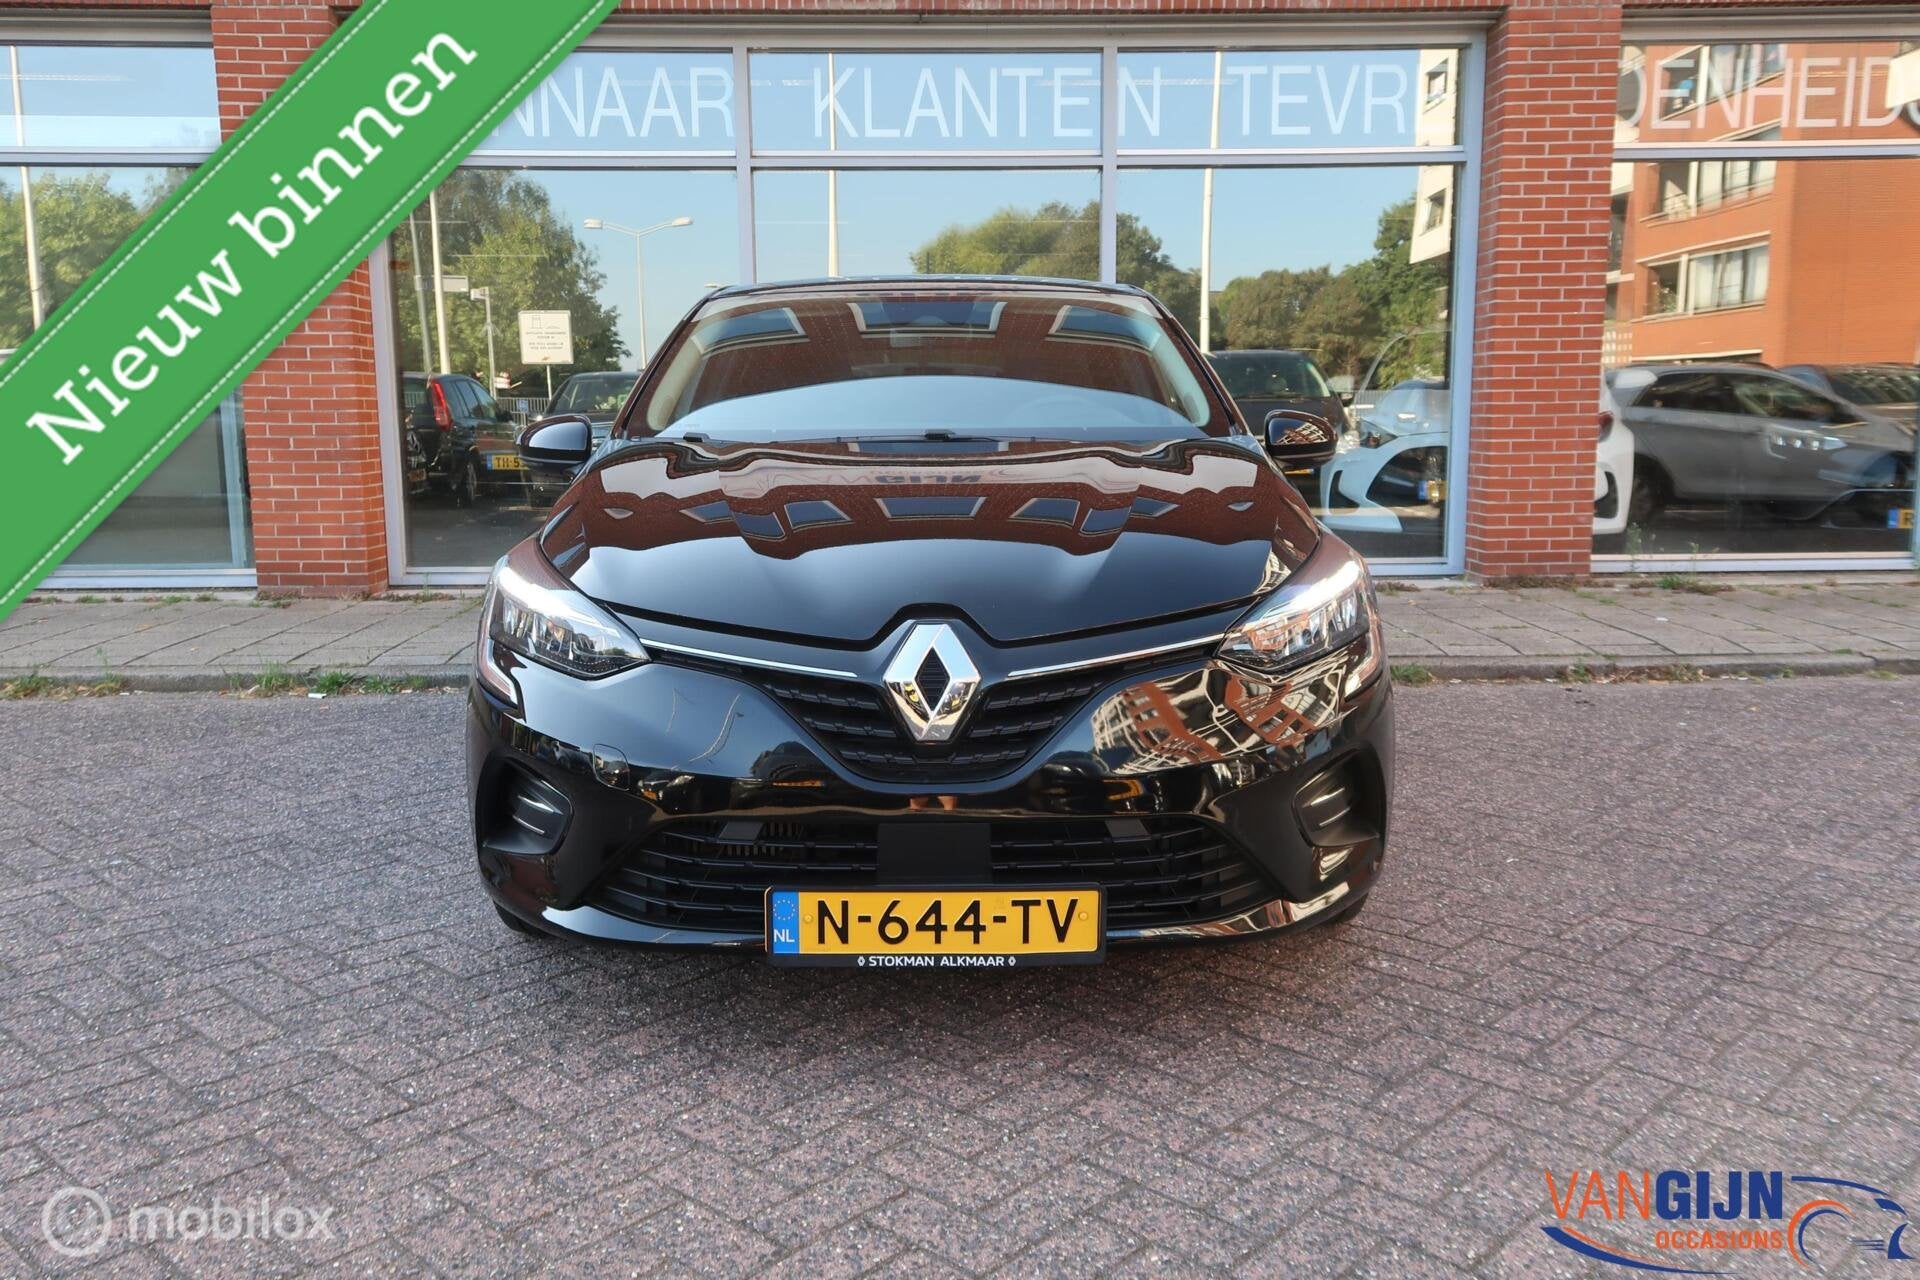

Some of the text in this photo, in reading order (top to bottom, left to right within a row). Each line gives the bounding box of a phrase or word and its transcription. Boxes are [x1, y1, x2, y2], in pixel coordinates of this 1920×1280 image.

[1226, 64, 1408, 136] TEVR
[773, 898, 1079, 945] NL N-644-TV
[868, 955, 1005, 967] STOKMAN ALKMAAR
